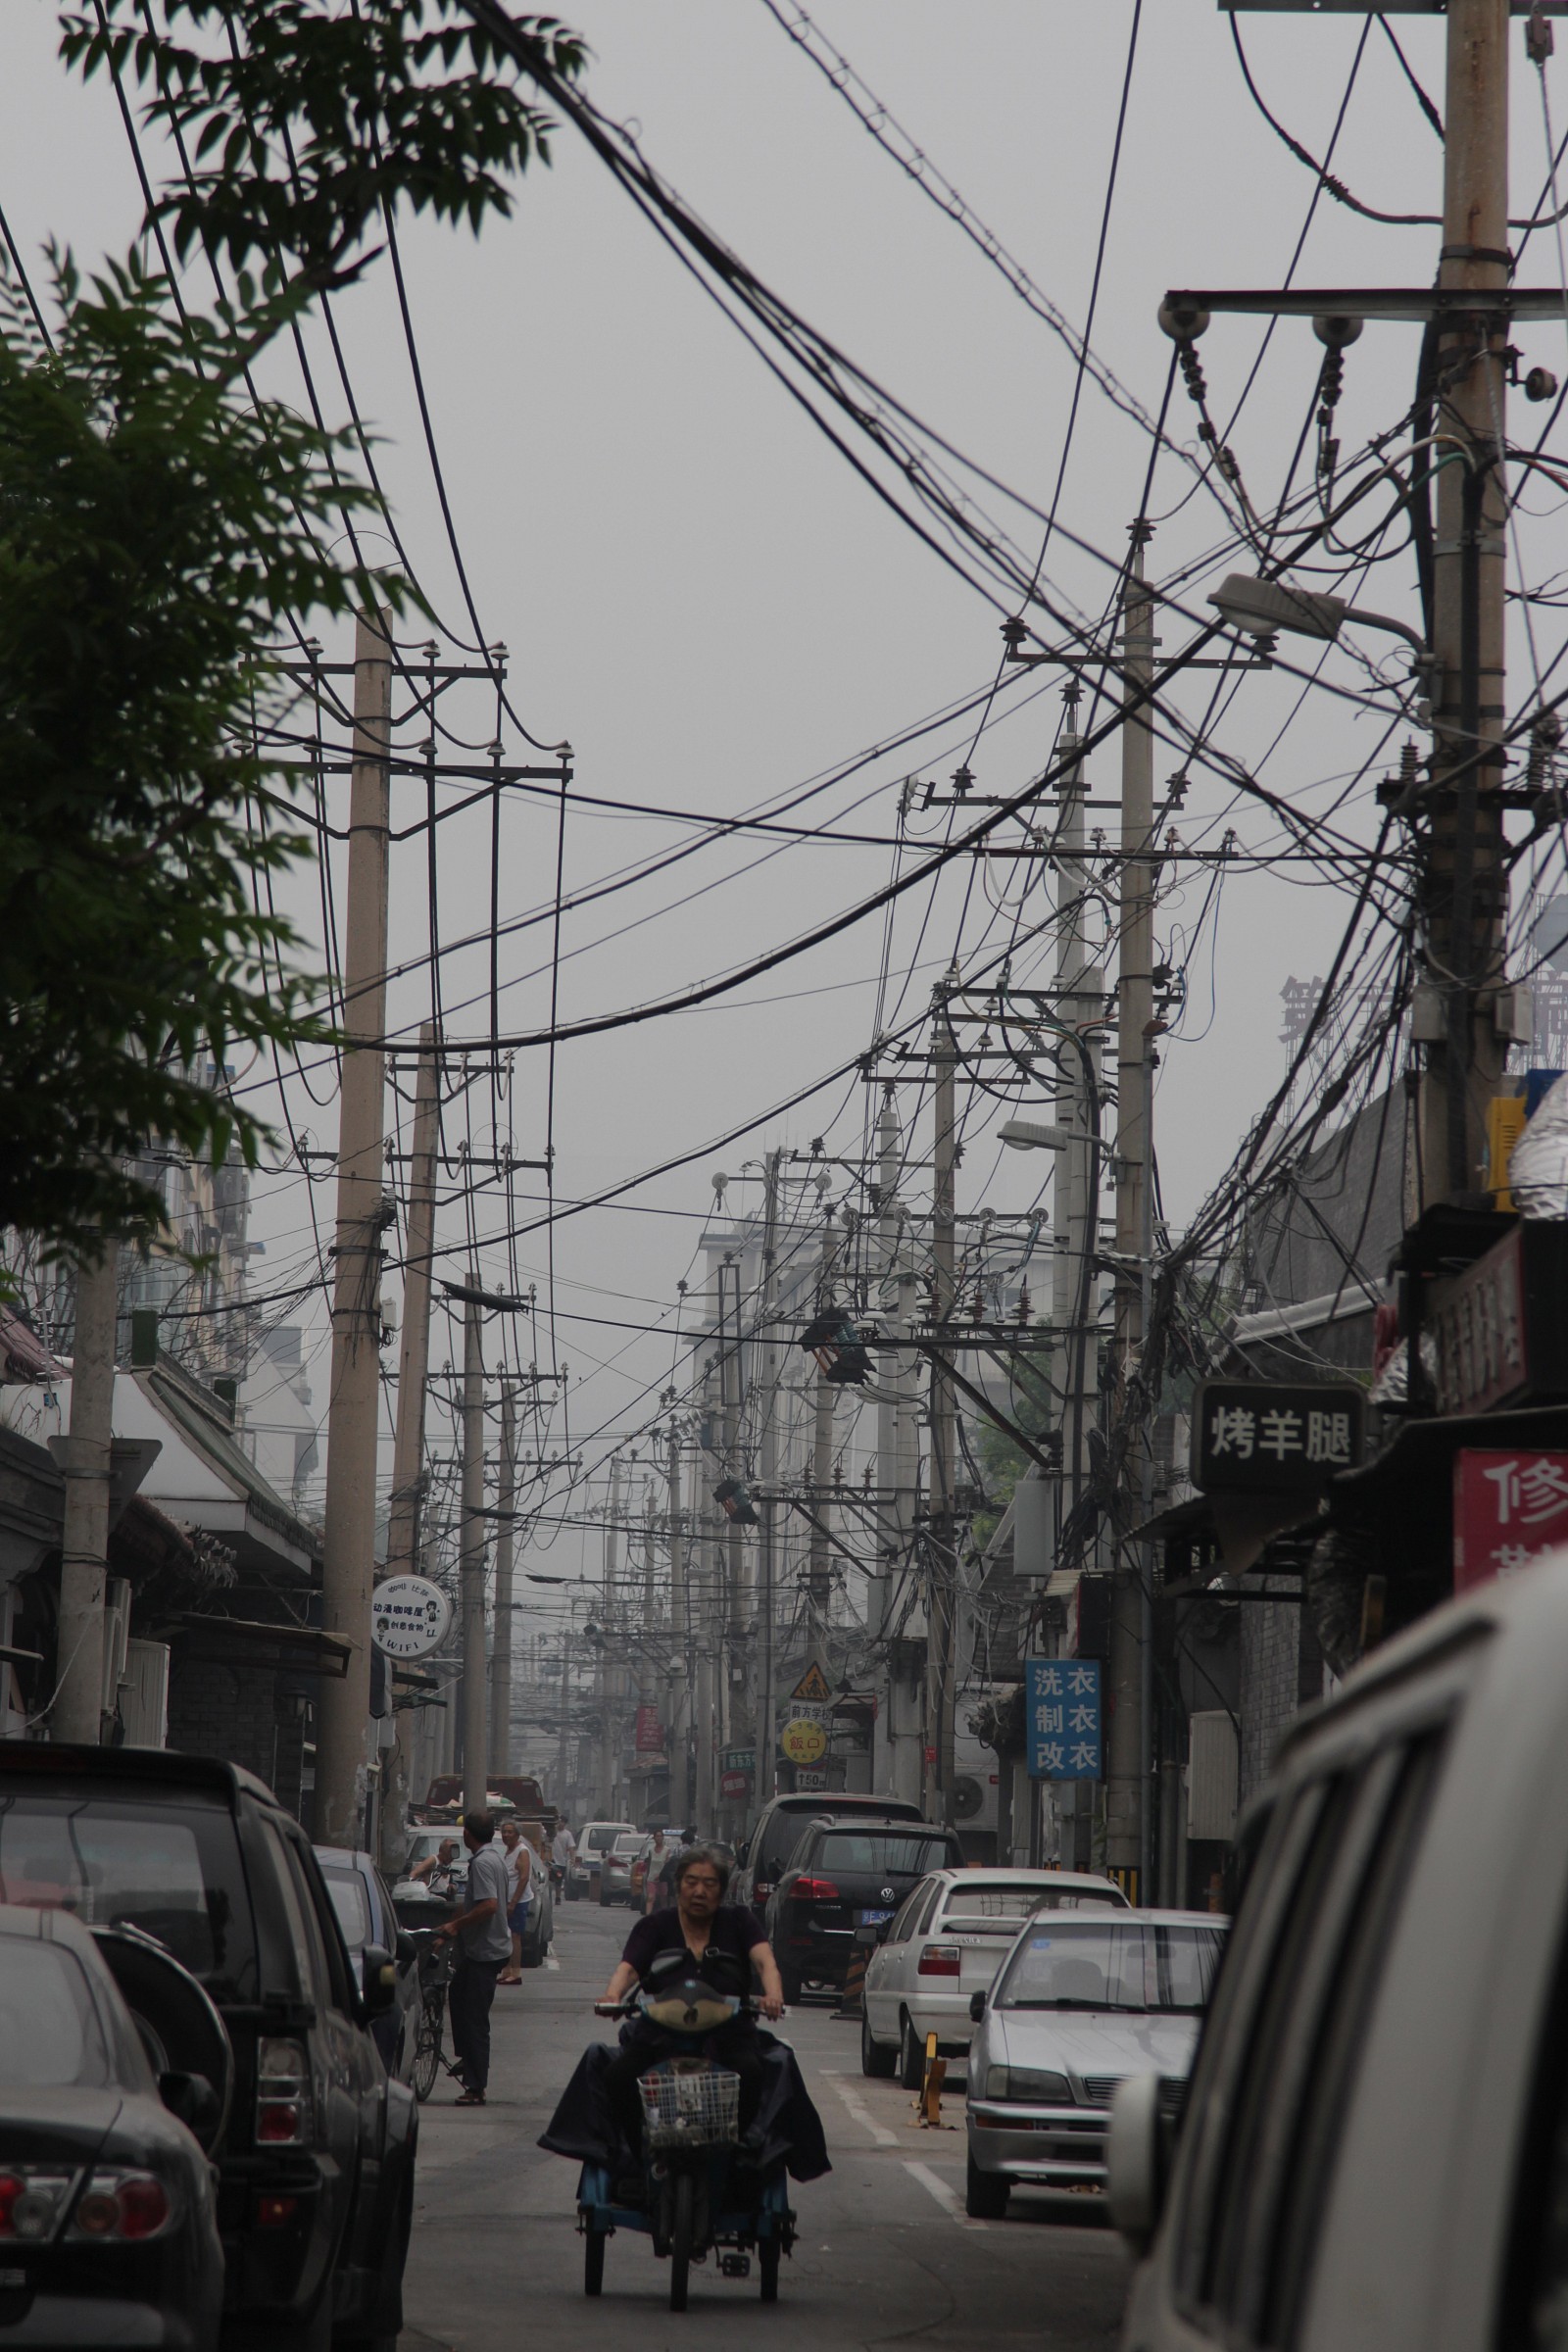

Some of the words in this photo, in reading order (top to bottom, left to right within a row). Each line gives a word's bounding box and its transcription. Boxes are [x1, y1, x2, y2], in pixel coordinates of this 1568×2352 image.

[1209, 1405, 1350, 1463] 烤羊腿
[1482, 1457, 1568, 1524] 修
[373, 1603, 424, 1617] 动漫咖啡屋
[391, 1621, 424, 1632] 创意食物
[387, 1640, 419, 1652] WIFI
[1034, 1667, 1097, 1696] 洗衣
[792, 1705, 832, 1720] 前方学校
[1035, 1704, 1098, 1734] 制衣
[1036, 1741, 1099, 1771] 改衣
